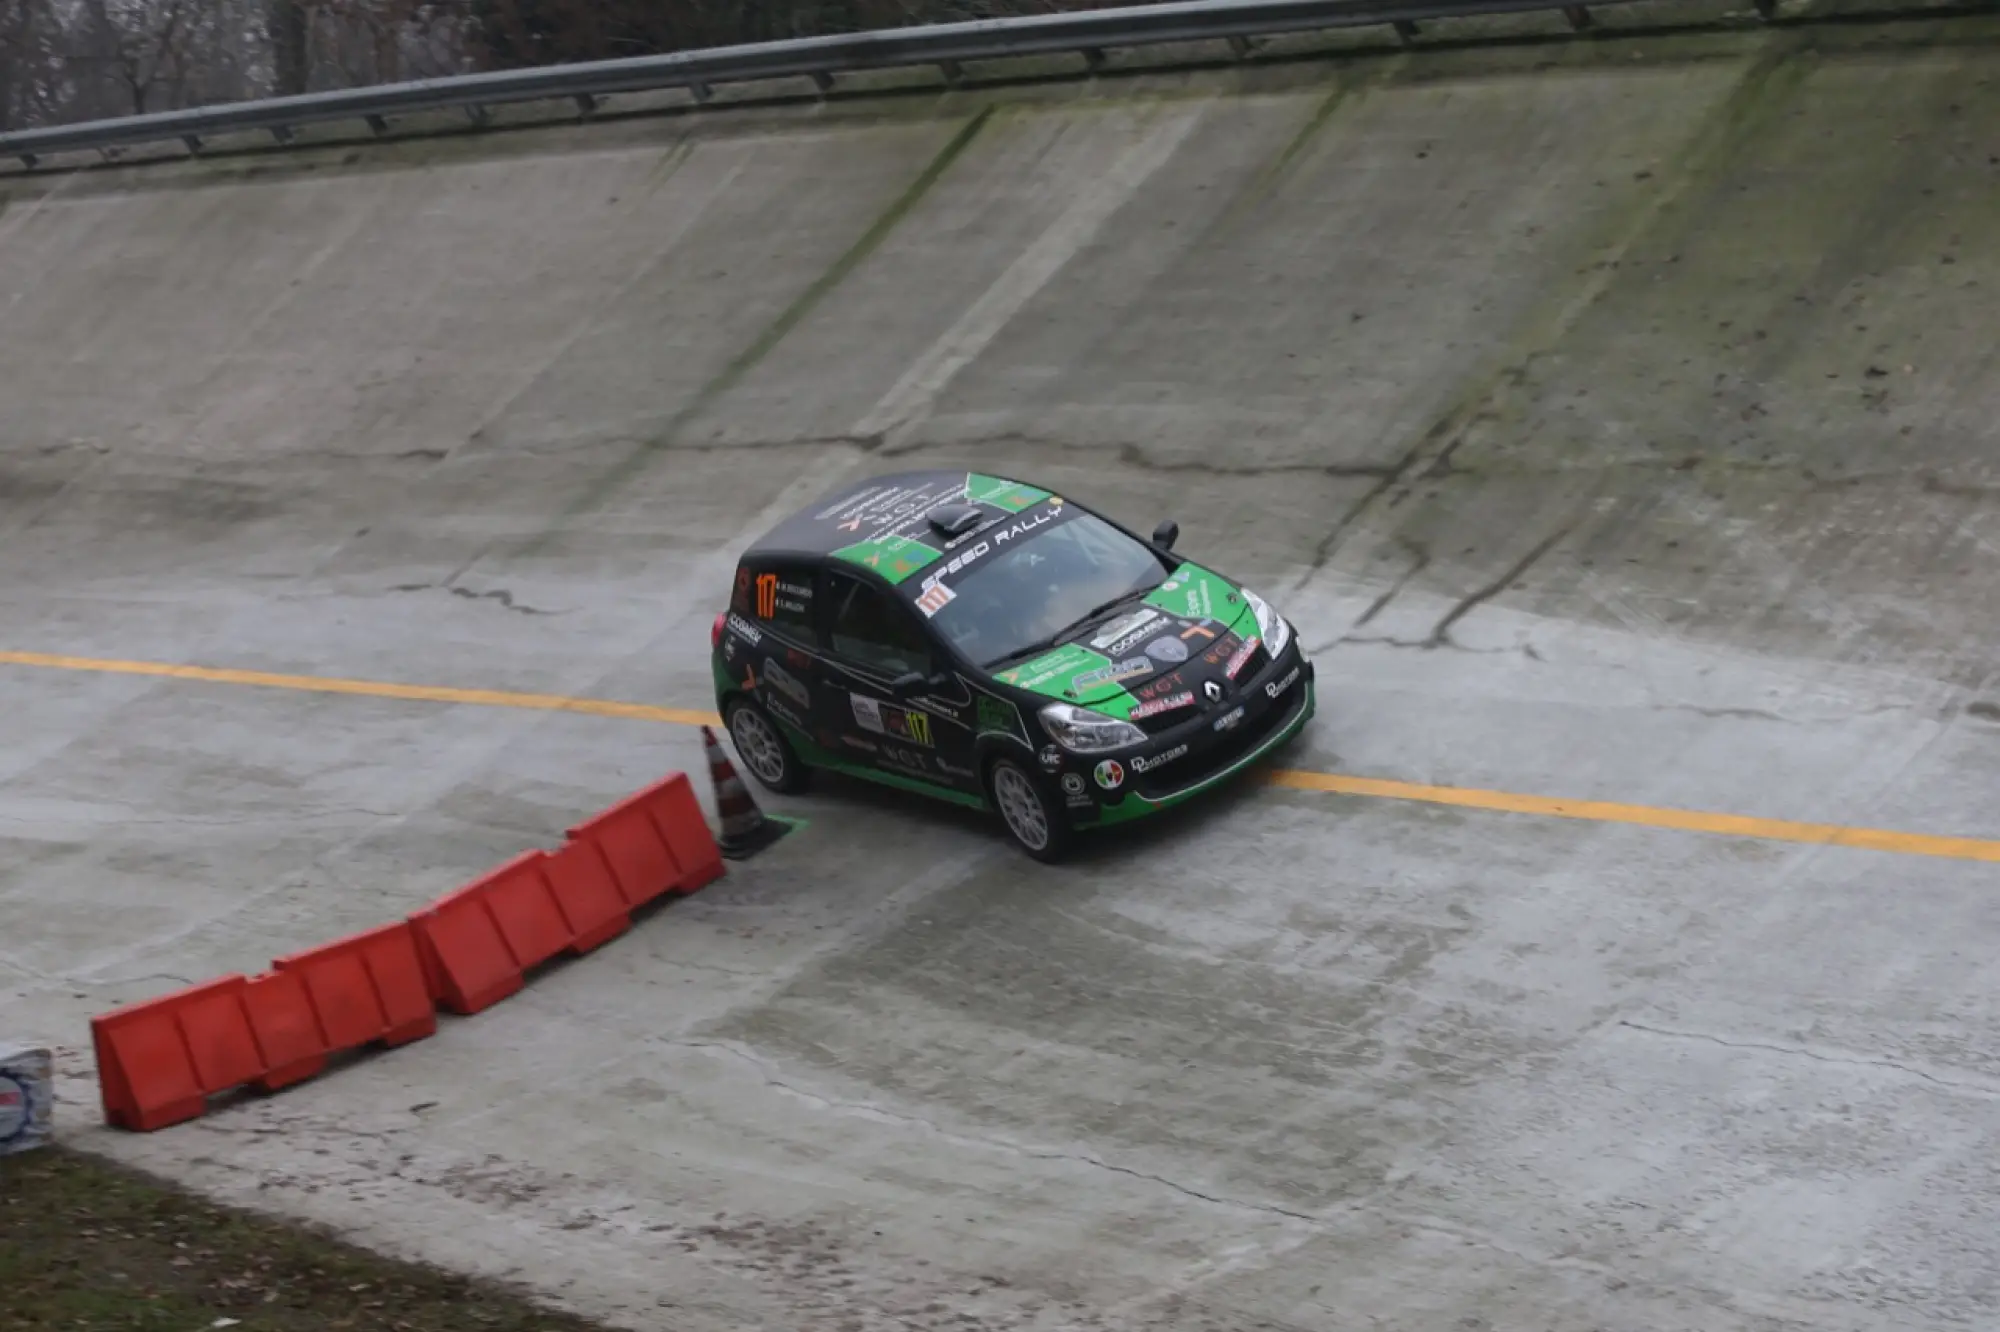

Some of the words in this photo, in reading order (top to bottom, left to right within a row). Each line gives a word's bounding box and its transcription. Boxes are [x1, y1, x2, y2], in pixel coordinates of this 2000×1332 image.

[921, 541, 990, 595] SPEED
[994, 505, 1062, 546] RALLY
[755, 572, 776, 620] 117
[918, 584, 950, 612] 117
[1140, 672, 1183, 699] WGT
[905, 710, 933, 747] 117
